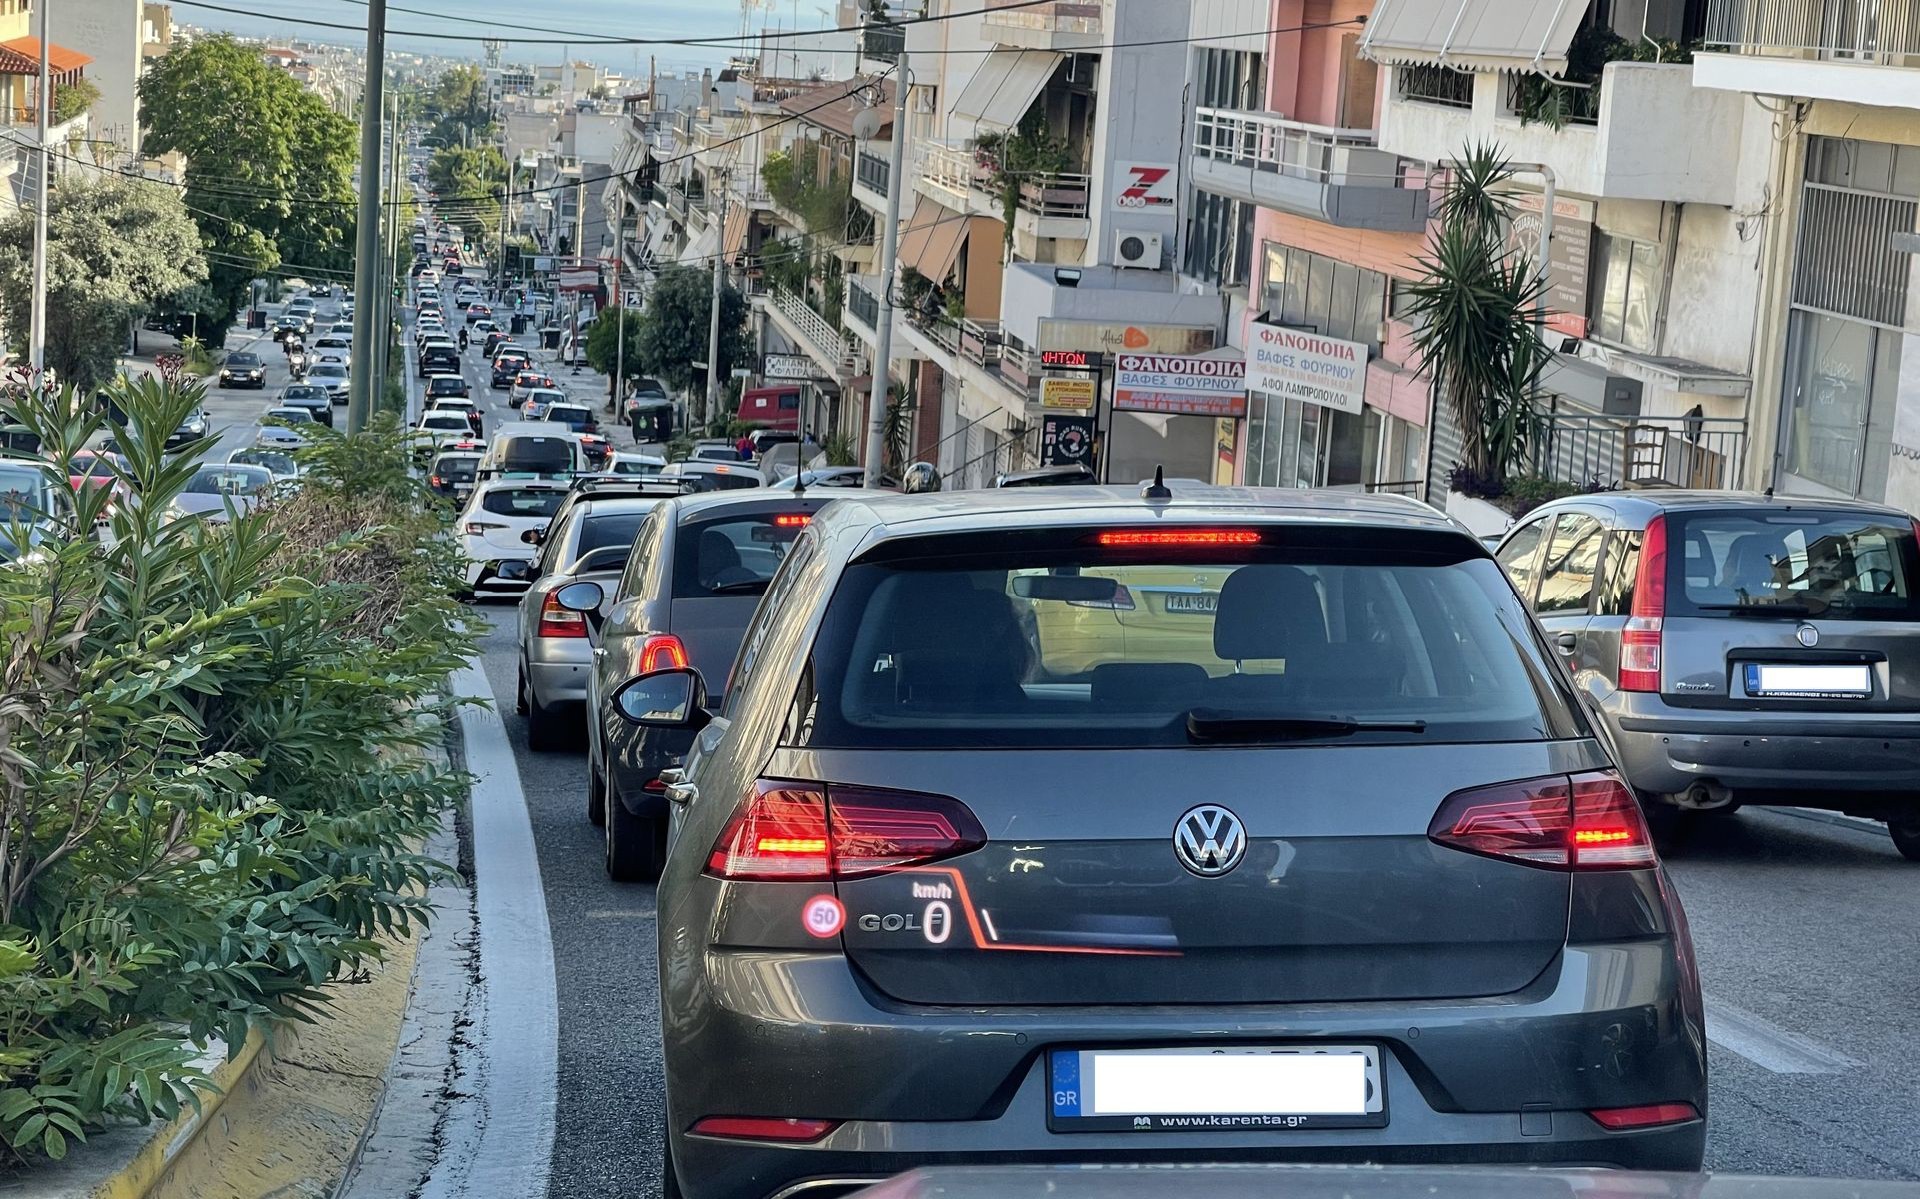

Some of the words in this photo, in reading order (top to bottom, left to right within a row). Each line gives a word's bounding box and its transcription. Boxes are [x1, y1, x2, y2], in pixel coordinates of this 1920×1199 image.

[1257, 348, 1296, 369] ΒΑΦΕΣ
[1300, 358, 1356, 381] ΦΟΥΡΝΟΥ
[1122, 373, 1168, 386] ΒΑΦΕΣ
[1173, 376, 1239, 390] ΦΟΥΡΝΟΥ
[1285, 381, 1348, 406] ΛΑΜΠΡΟΠΟΥΛΟΙ
[912, 882, 952, 899] km/h
[812, 908, 837, 925] 50
[922, 900, 952, 944] 0
[1053, 1091, 1078, 1106] GR
[1160, 1115, 1308, 1127] www.karenta.gr
